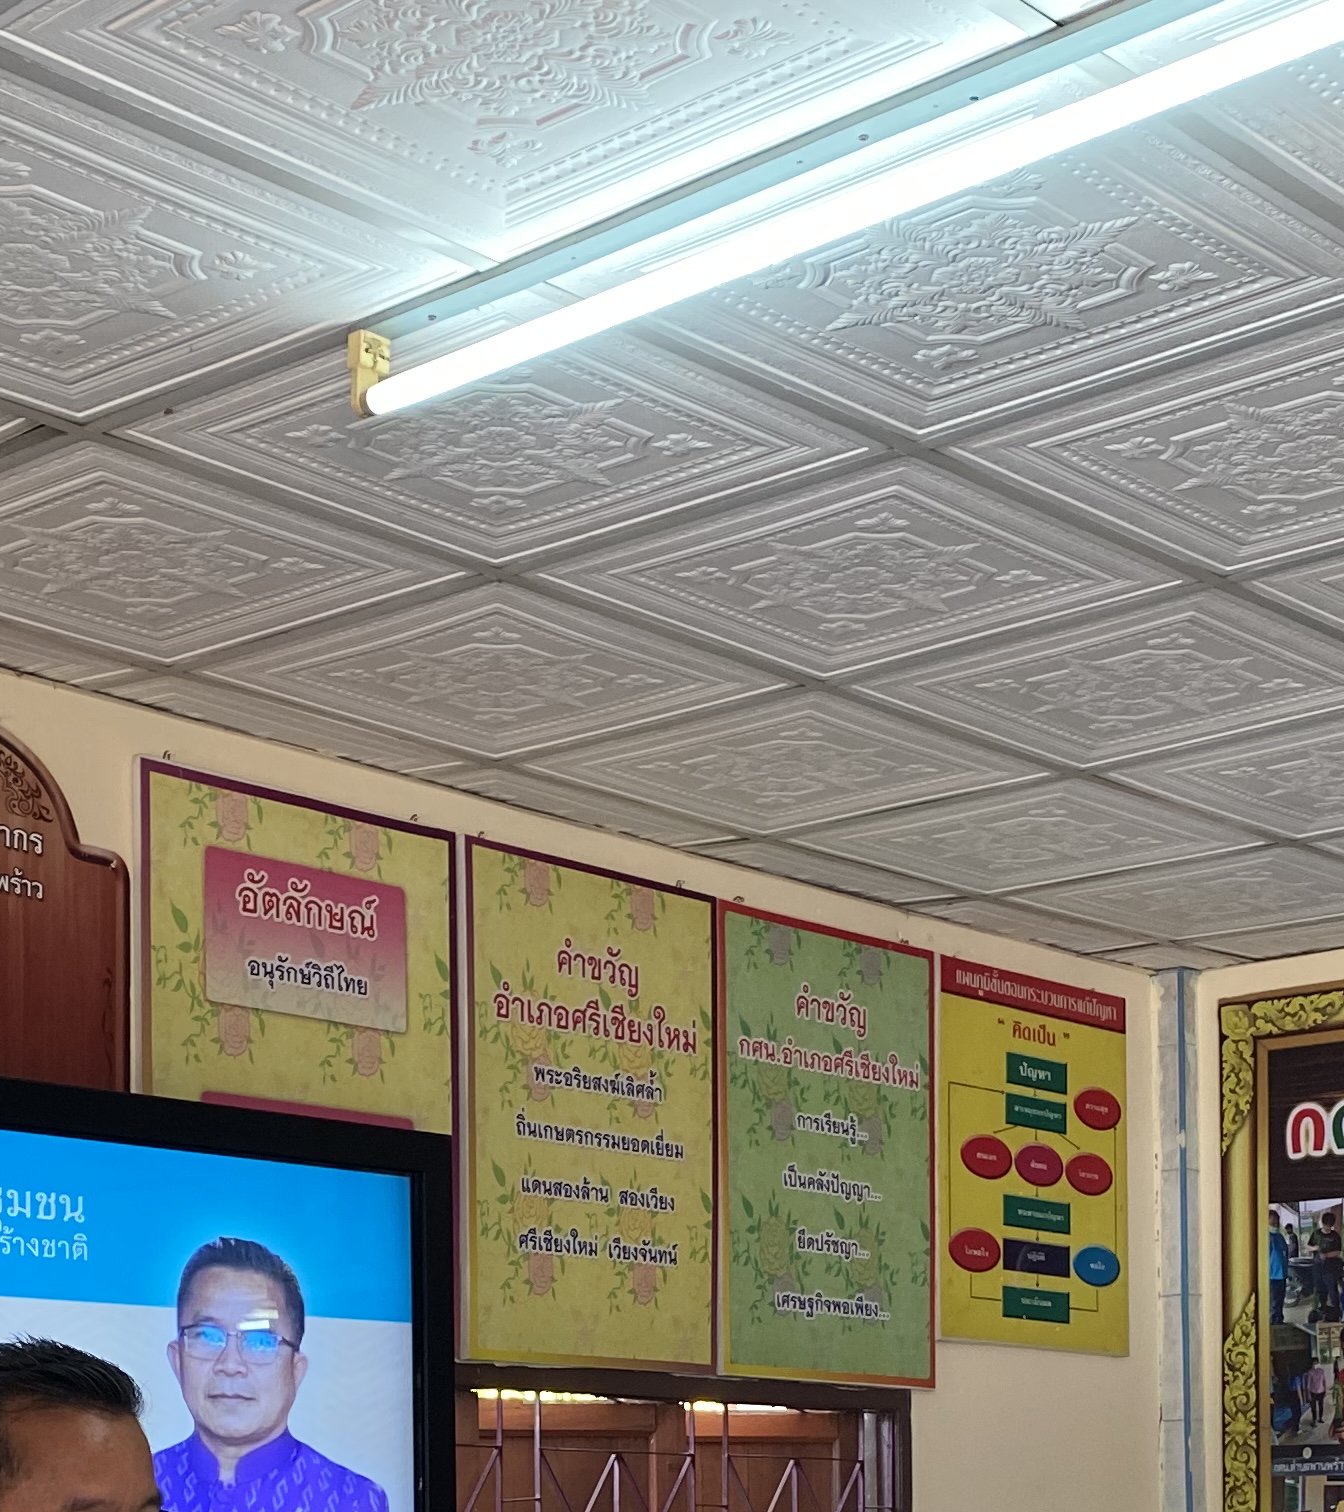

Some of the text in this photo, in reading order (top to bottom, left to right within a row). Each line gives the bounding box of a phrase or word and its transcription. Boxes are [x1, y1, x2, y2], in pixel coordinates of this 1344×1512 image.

[236, 869, 379, 939] อัตลักษณ์
[246, 955, 369, 997] อนุรักษ์วิถีไทย
[556, 938, 640, 998] คำขวัญ
[492, 983, 699, 1057] อำเภอศรีเชียงใหม่
[795, 984, 867, 1038] คำขวัญ
[533, 1066, 663, 1103] พระอริยสงฆ์เลิศล้ำ
[739, 1038, 920, 1089] กศน.อำเภอศรีเชียงใหม่
[515, 1107, 685, 1159] ถิ่นเกษตรกรรมยอดเยี่ยม
[618, 1187, 676, 1212] สองเวียง
[518, 1226, 680, 1266] ศรีเชียงใหม่ เวียงจันทน์
